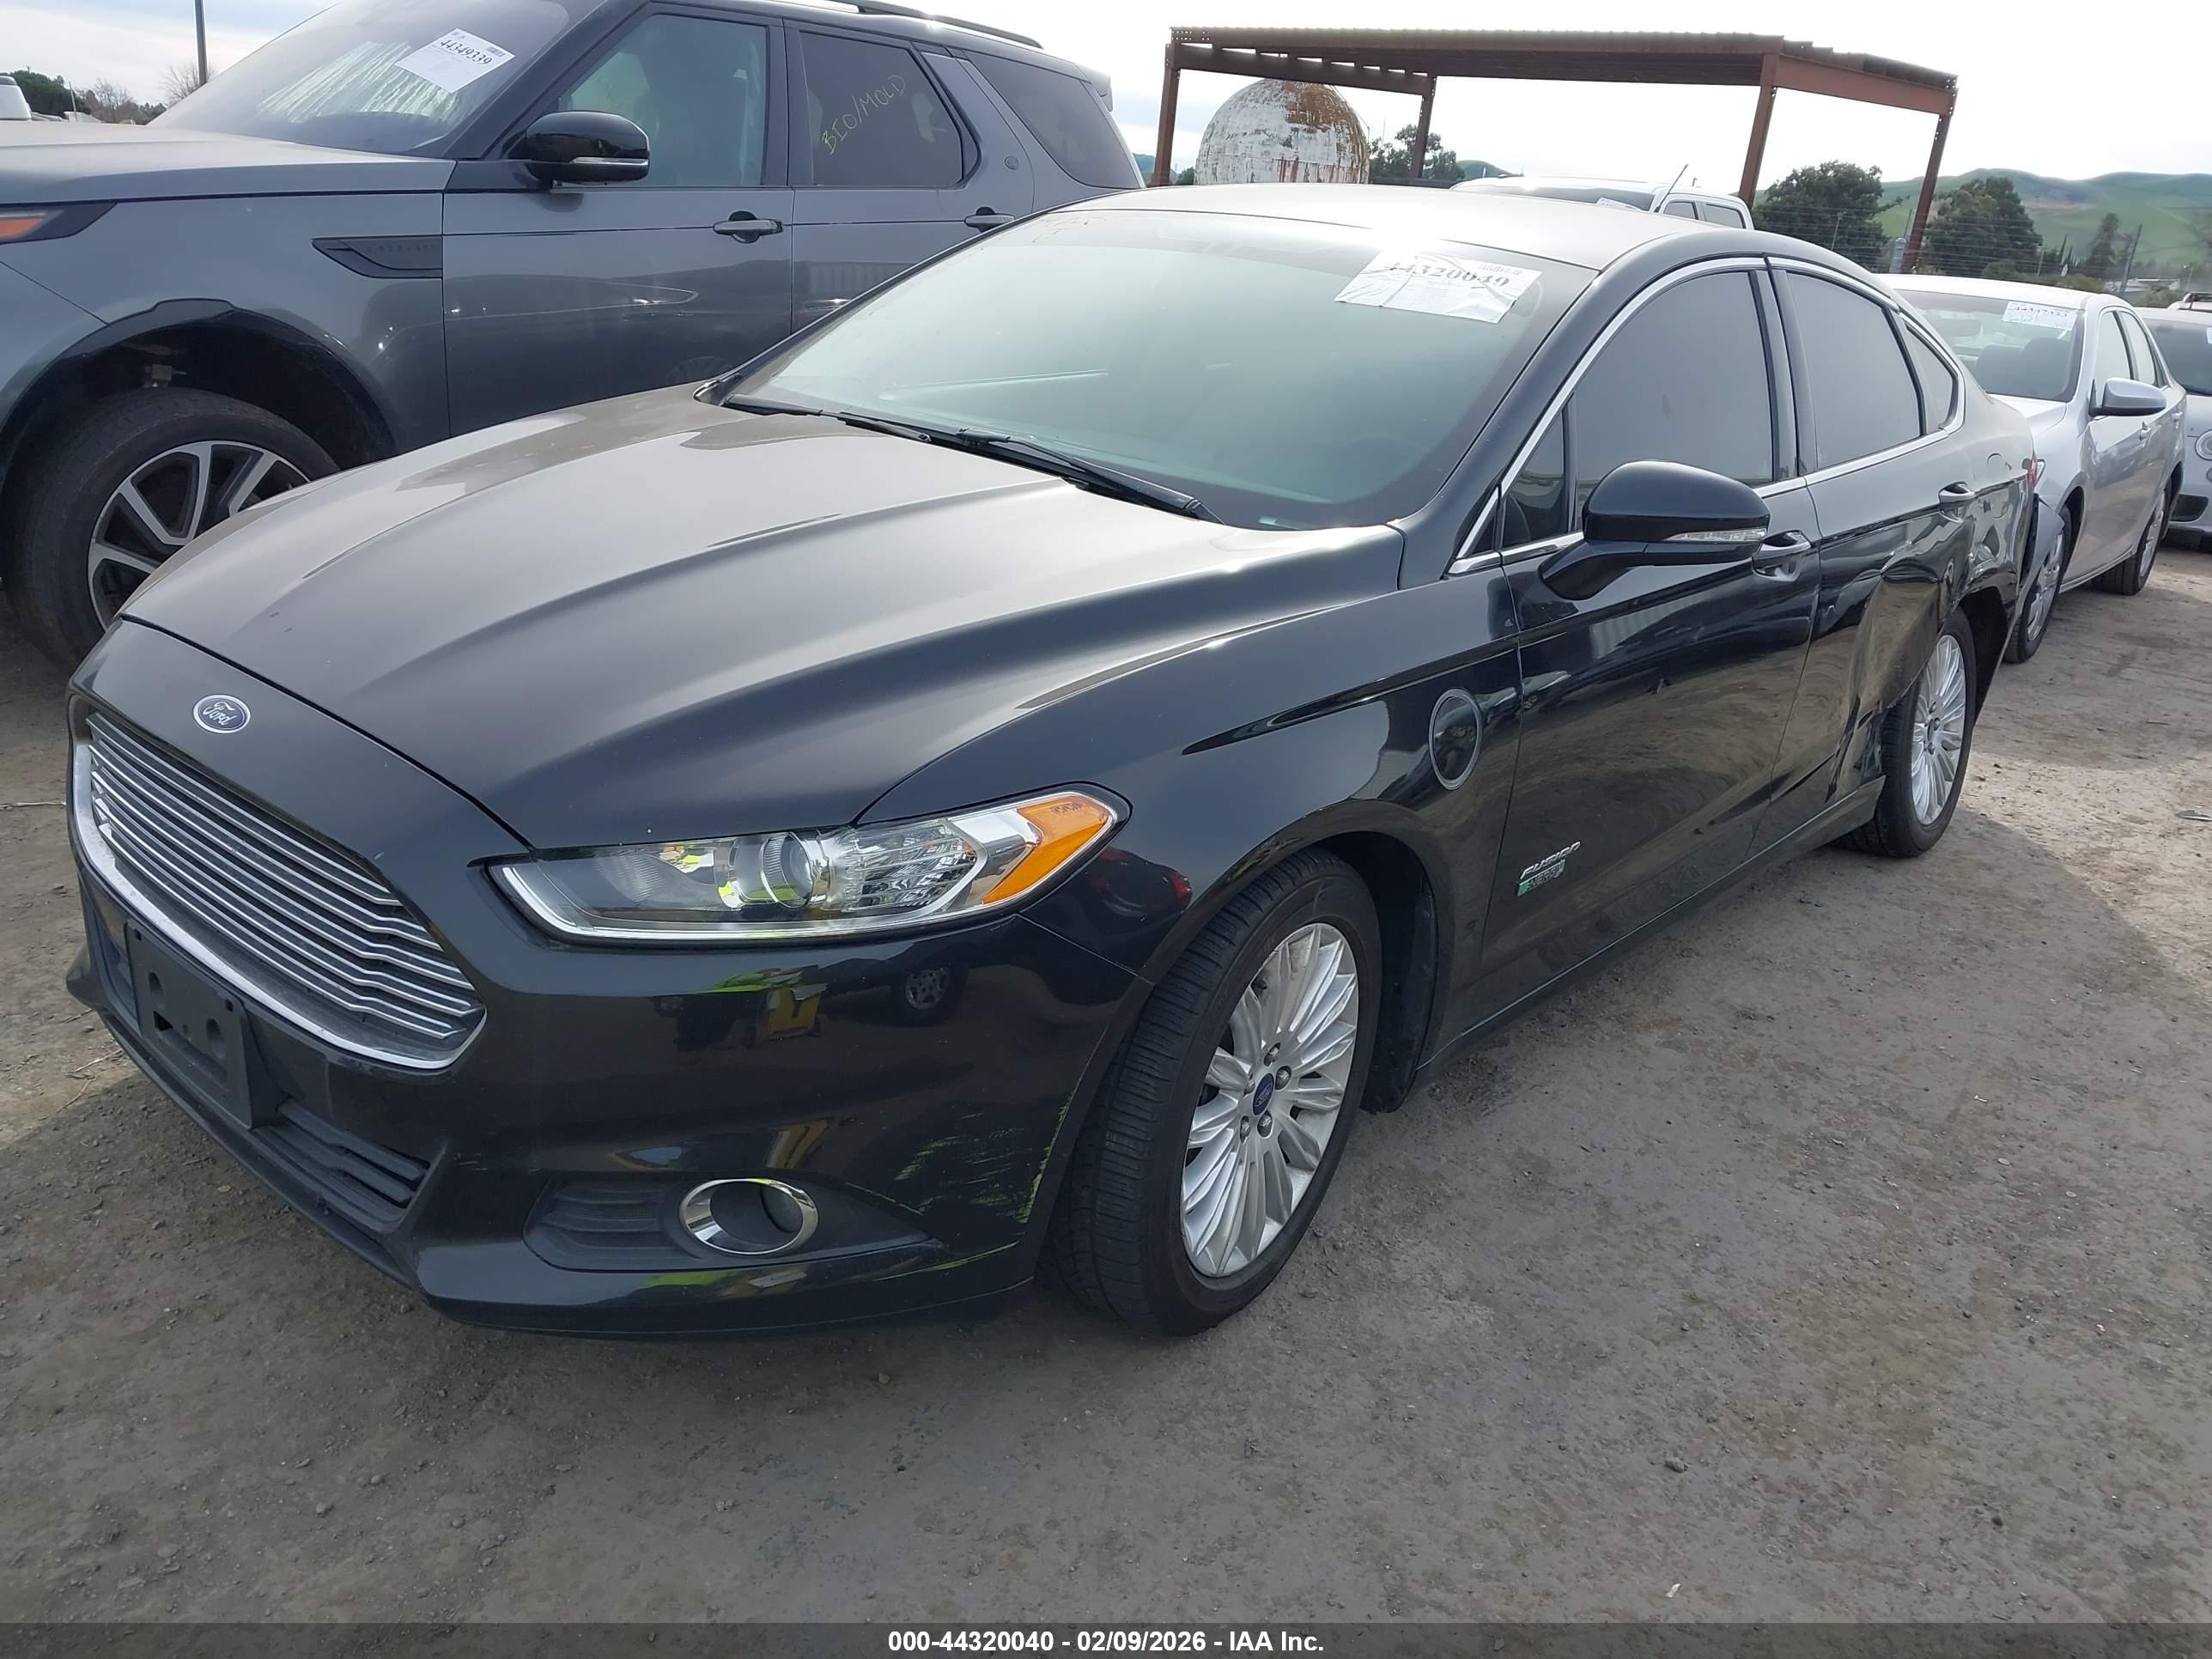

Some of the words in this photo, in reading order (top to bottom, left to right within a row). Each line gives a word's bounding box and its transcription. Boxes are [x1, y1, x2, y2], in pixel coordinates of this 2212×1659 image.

[440, 40, 493, 65] 44349339
[821, 75, 906, 155] BIO/MOLD
[203, 702, 238, 726] Ford
